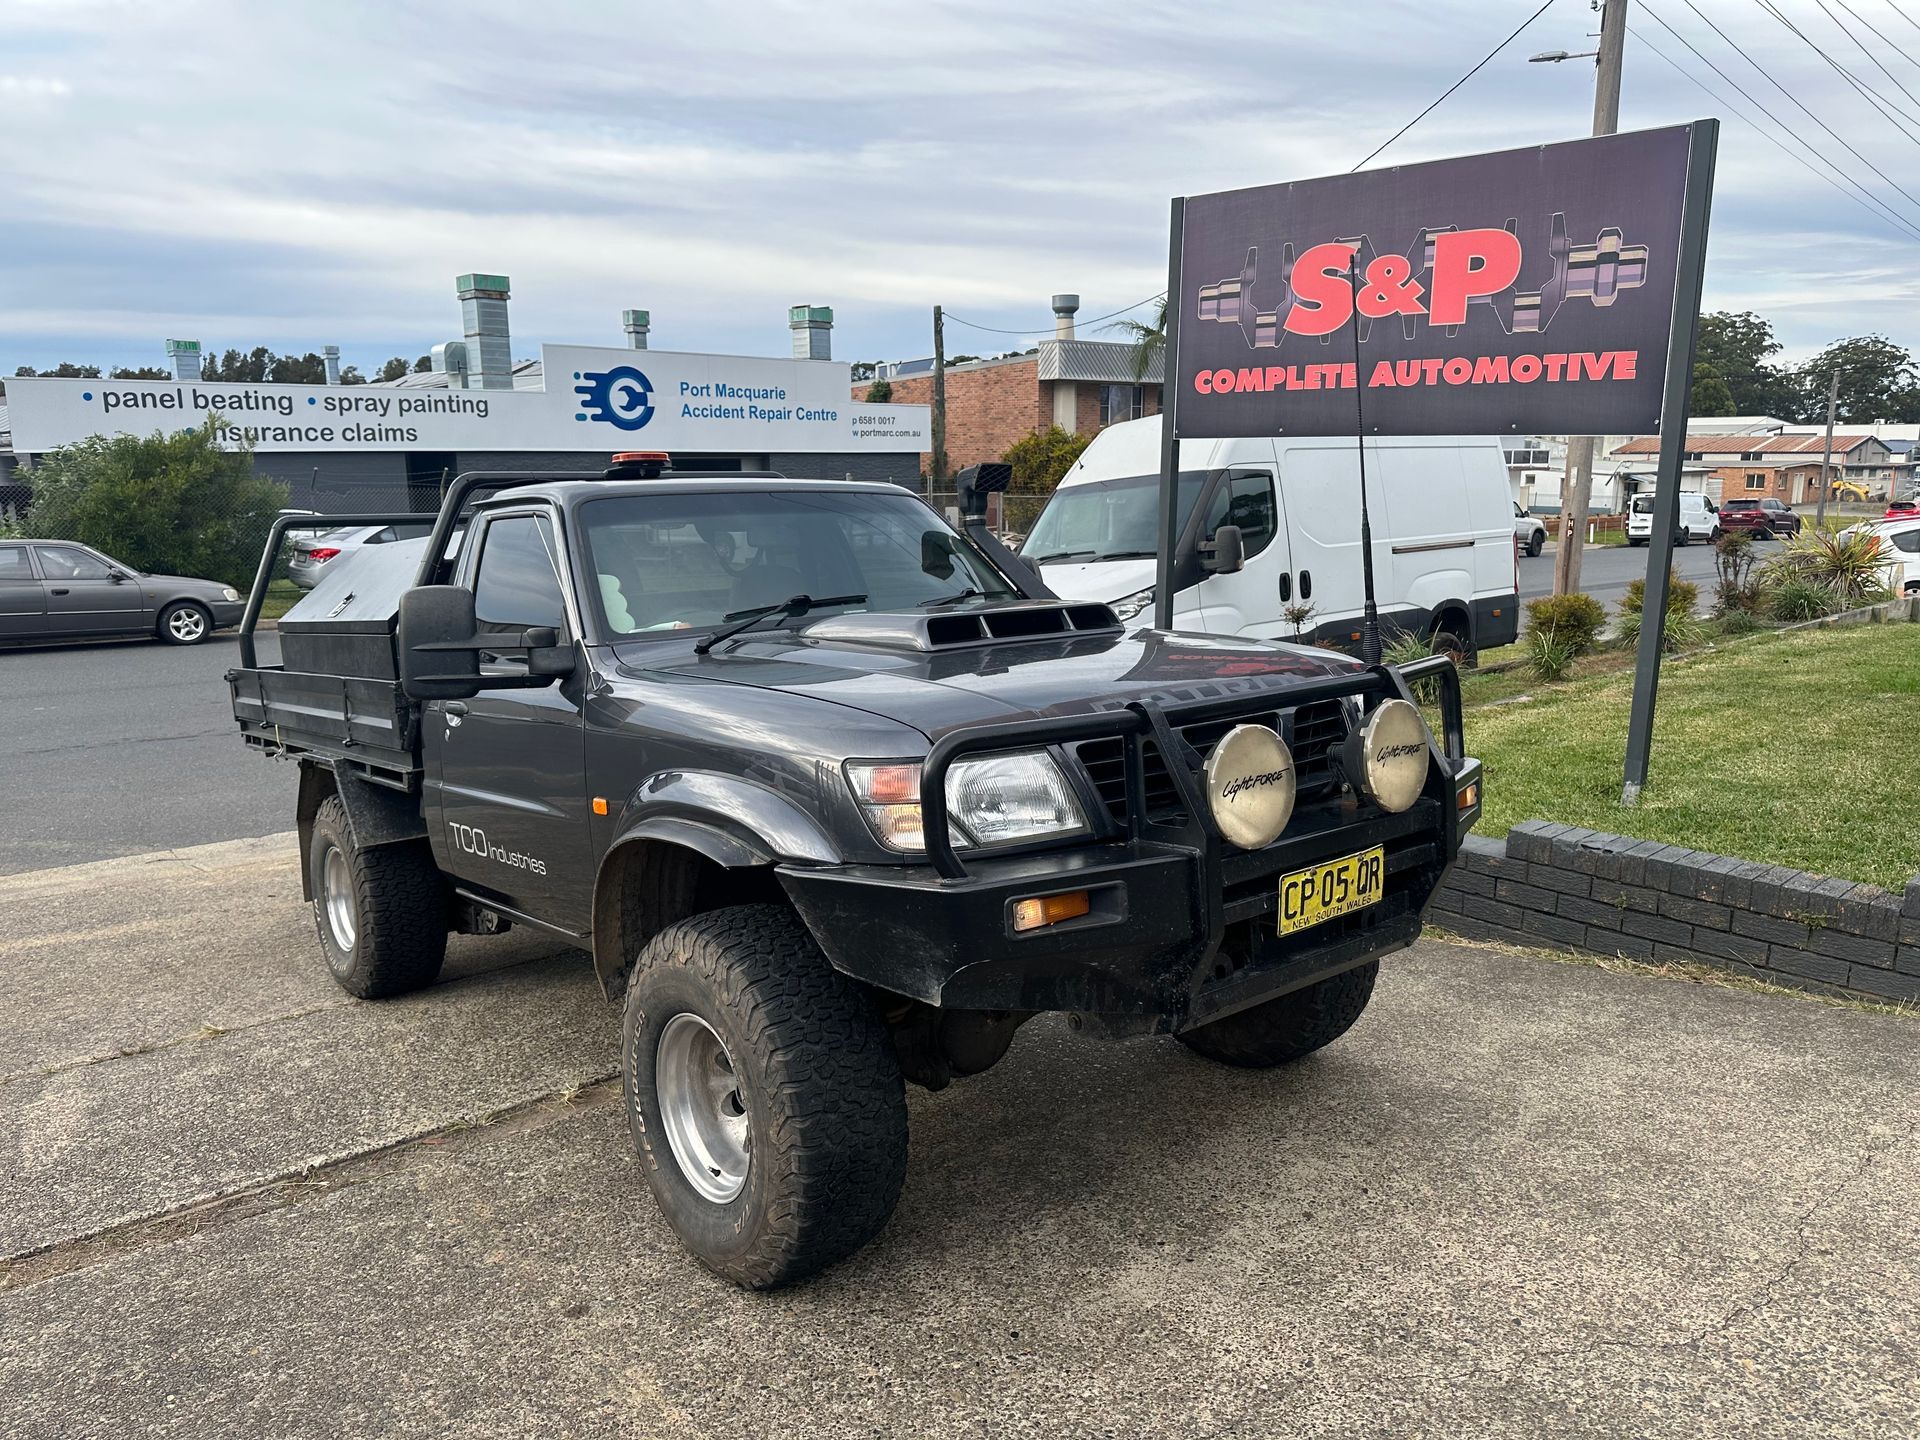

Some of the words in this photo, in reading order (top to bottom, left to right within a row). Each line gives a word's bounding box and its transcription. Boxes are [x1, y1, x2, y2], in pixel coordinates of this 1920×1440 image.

[1282, 228, 1523, 337] S&P
[1194, 362, 1358, 395] COMPLETE
[1367, 350, 1639, 388] AUTOMOTIVE
[102, 388, 184, 413] panel
[192, 388, 293, 416] beating
[324, 396, 391, 417] spray
[399, 394, 489, 418] painting
[680, 381, 711, 397] Port
[715, 383, 786, 401] Macquarie
[681, 403, 745, 419] Accident
[749, 405, 792, 423] Repair
[796, 407, 838, 421] Centre
[852, 417, 857, 426] p
[858, 415, 876, 425] 6581
[878, 416, 896, 425] 0017
[341, 422, 418, 442] claims
[860, 429, 921, 438] portmarc.com.au
[449, 821, 488, 857] TCO
[487, 841, 547, 876] Industries
[1292, 915, 1312, 930] NEW
[1315, 905, 1343, 922] SOUTH
[1346, 894, 1372, 911] WALES
